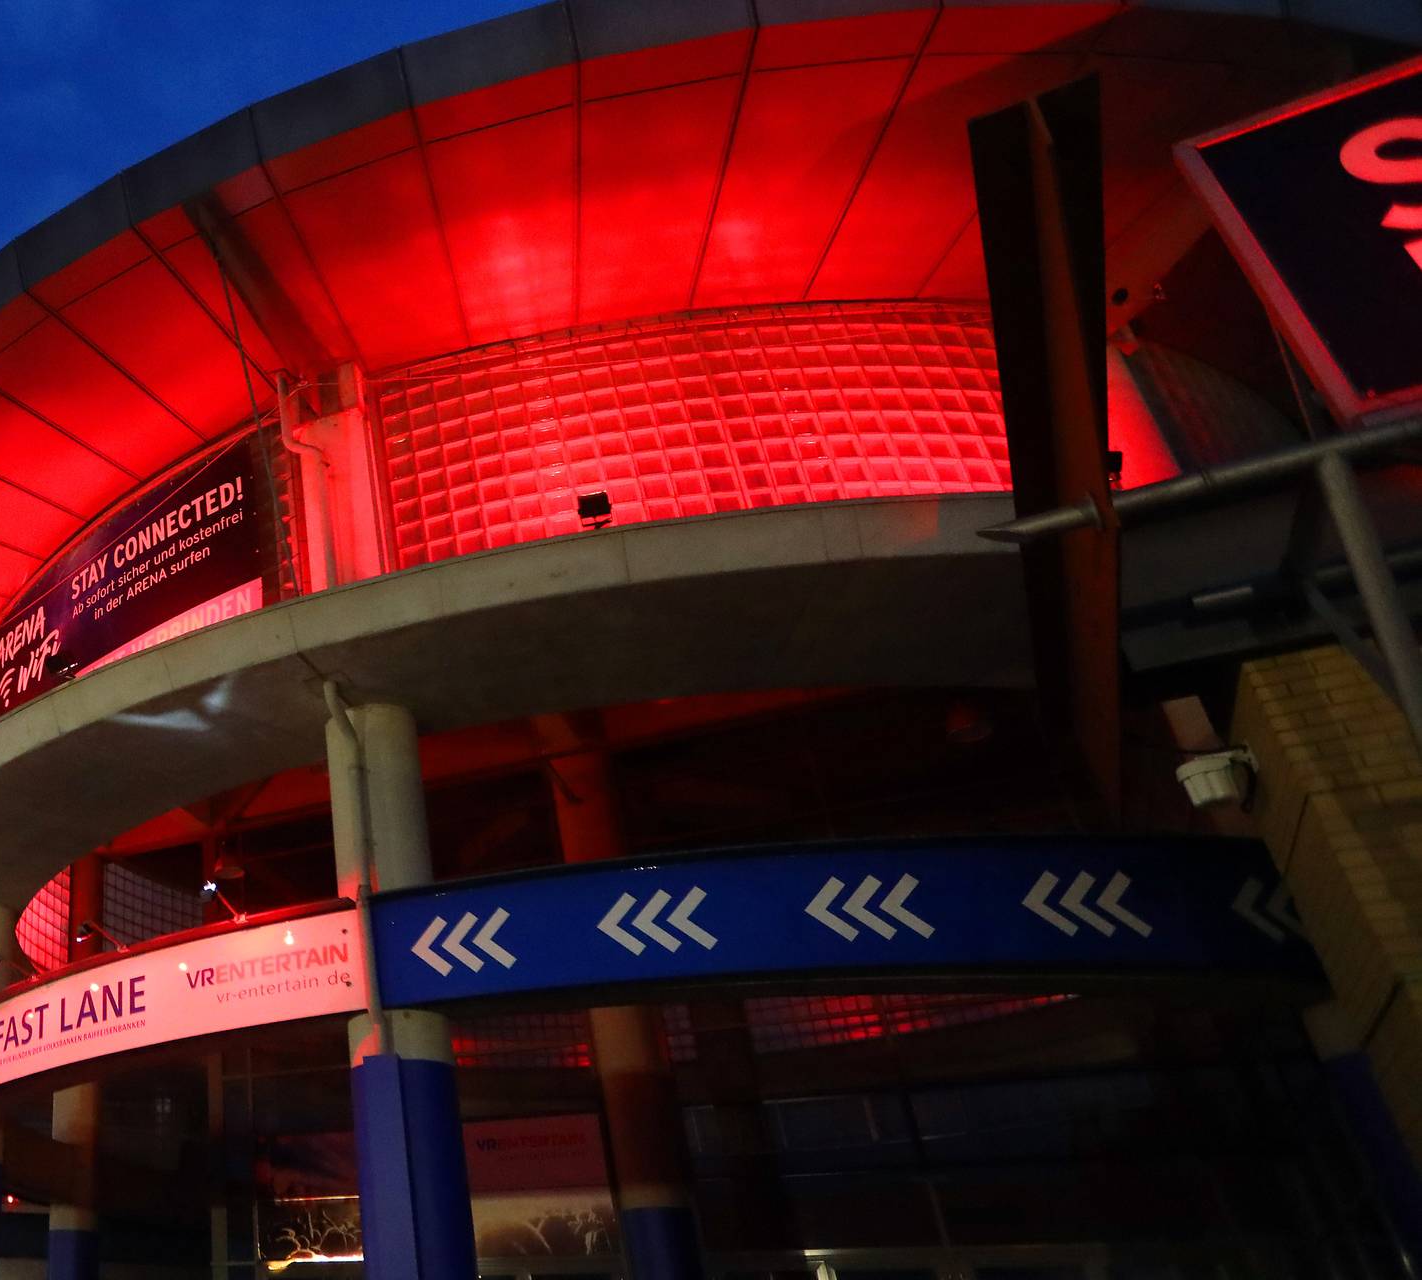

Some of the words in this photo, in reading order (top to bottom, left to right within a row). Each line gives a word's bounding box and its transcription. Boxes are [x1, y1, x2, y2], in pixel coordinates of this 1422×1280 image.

[71, 553, 108, 600] STAY
[114, 476, 244, 569] CONNECTED!
[72, 602, 83, 619] Ab
[86, 581, 116, 608] sofort
[118, 558, 151, 587] sicher
[154, 543, 176, 566] und
[179, 508, 244, 552] kostenfrei
[94, 607, 104, 620] in
[106, 593, 124, 612] der
[127, 568, 168, 600] ARENA
[170, 546, 211, 575] surfen
[186, 943, 349, 989] VRENTERTAIN
[60, 975, 146, 1032] LANE
